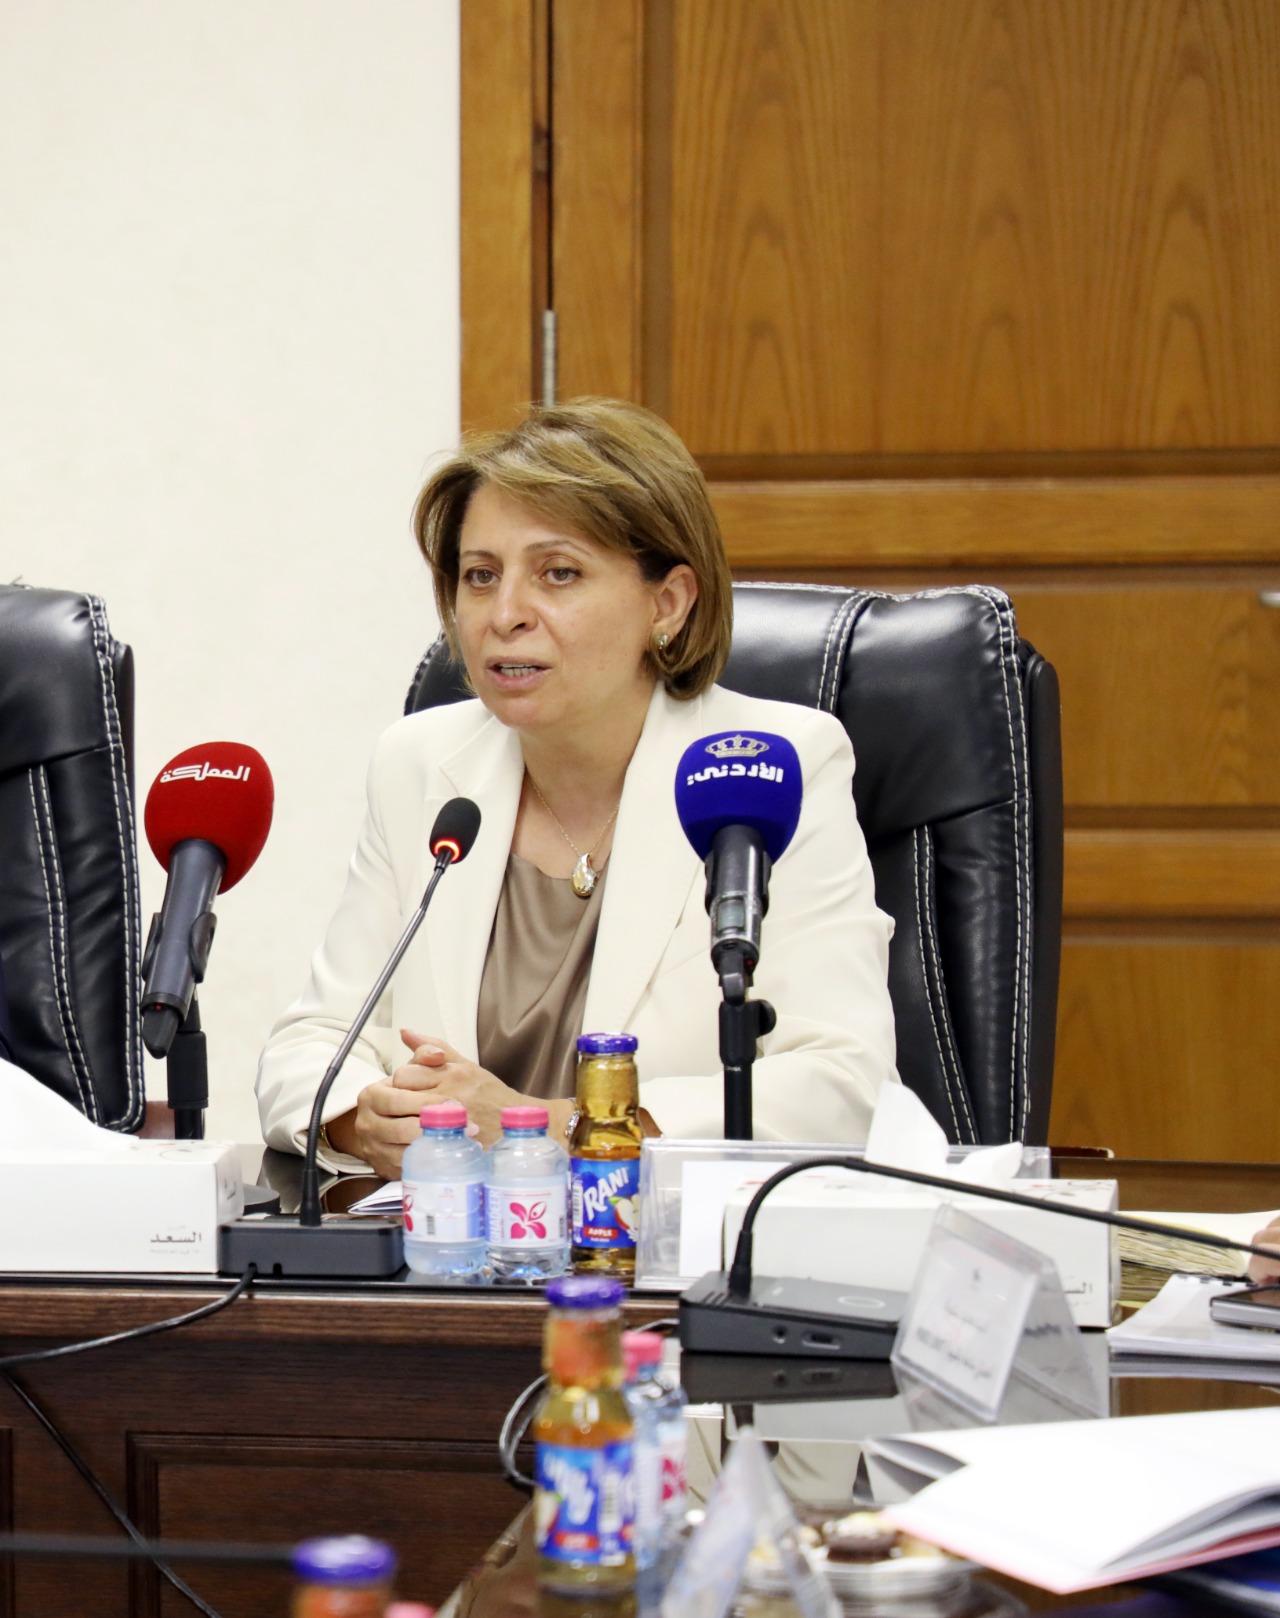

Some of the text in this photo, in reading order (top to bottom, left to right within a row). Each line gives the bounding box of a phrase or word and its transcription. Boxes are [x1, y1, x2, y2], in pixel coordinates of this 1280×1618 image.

[160, 761, 251, 783] المملكة
[686, 762, 784, 786] الأردني
[584, 1167, 629, 1221] RANI
[489, 1189, 502, 1243] GHADEER
[588, 1228, 613, 1237] APPLE
